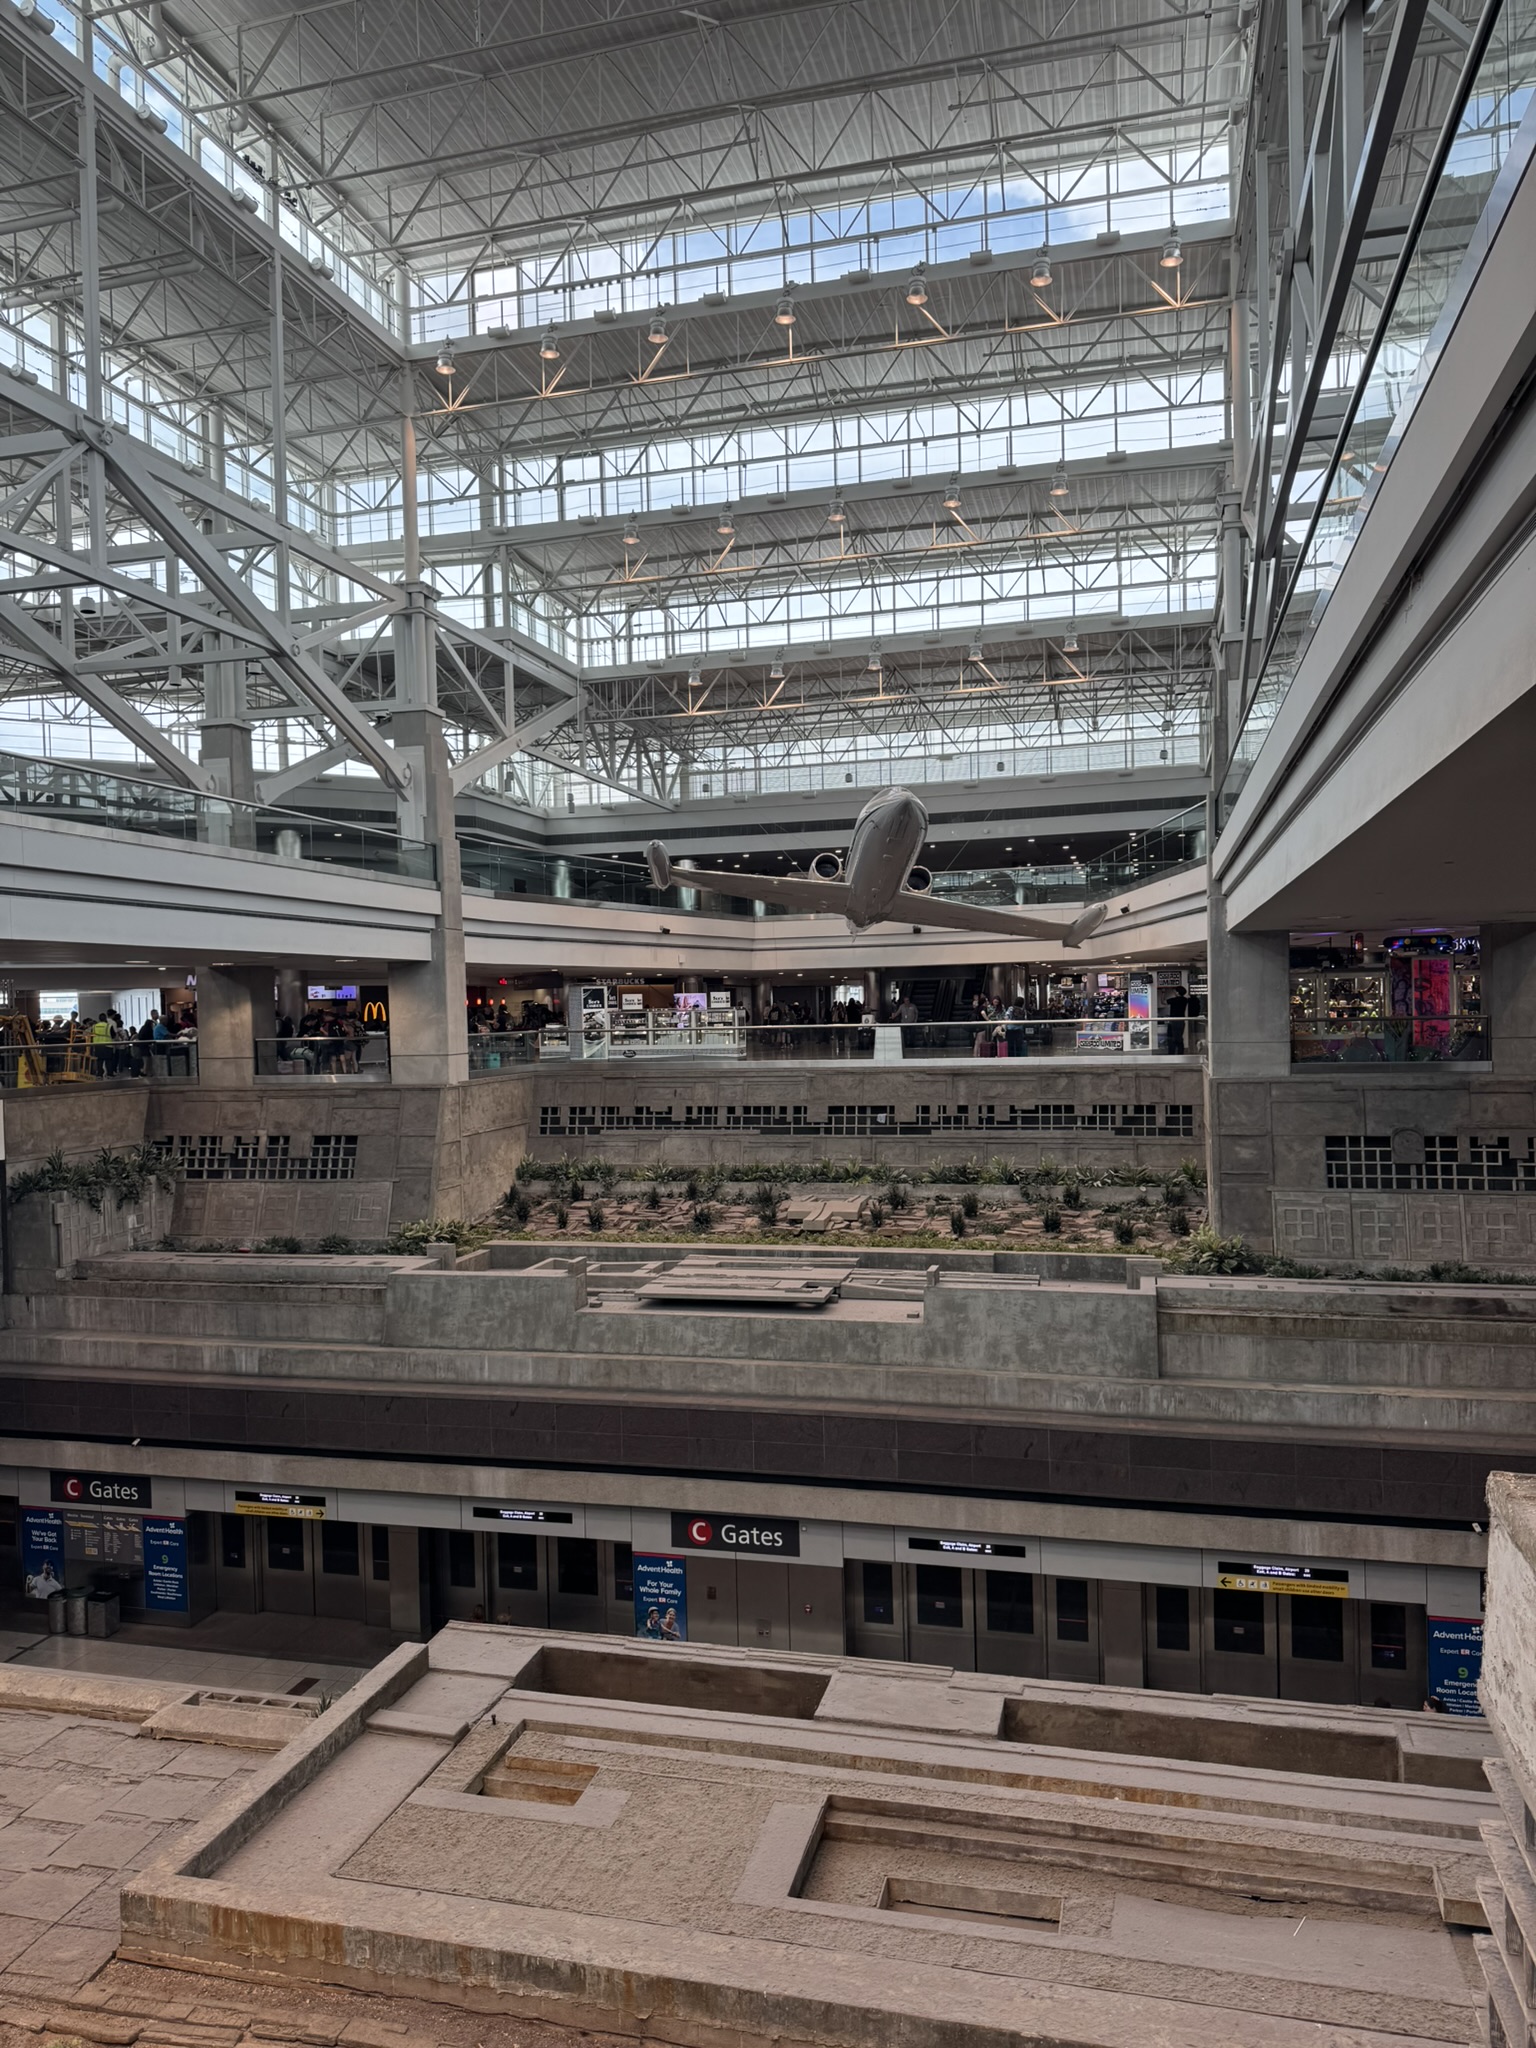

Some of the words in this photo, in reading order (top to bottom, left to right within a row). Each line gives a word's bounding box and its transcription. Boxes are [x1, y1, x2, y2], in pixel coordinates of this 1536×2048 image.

[67, 1479, 79, 1496] C
[89, 1480, 139, 1500] Gates
[26, 1516, 62, 1525] AdventHealth
[145, 1526, 184, 1535] AdventHealth
[692, 1522, 707, 1541] C
[721, 1524, 783, 1547] Gates
[161, 1554, 169, 1564] 9
[153, 1564, 178, 1573] Emergency
[637, 1564, 683, 1575] AdventHealth
[162, 1571, 183, 1579] Locations
[646, 1579, 658, 1587] For
[658, 1581, 674, 1589] Your
[639, 1585, 659, 1594] Whole
[660, 1588, 682, 1598] Family
[1433, 1630, 1482, 1642] AdventHea
[1439, 1647, 1459, 1656] Expert
[1460, 1648, 1470, 1656] ER
[1457, 1666, 1469, 1679] 9
[1458, 1688, 1477, 1696] Locat
